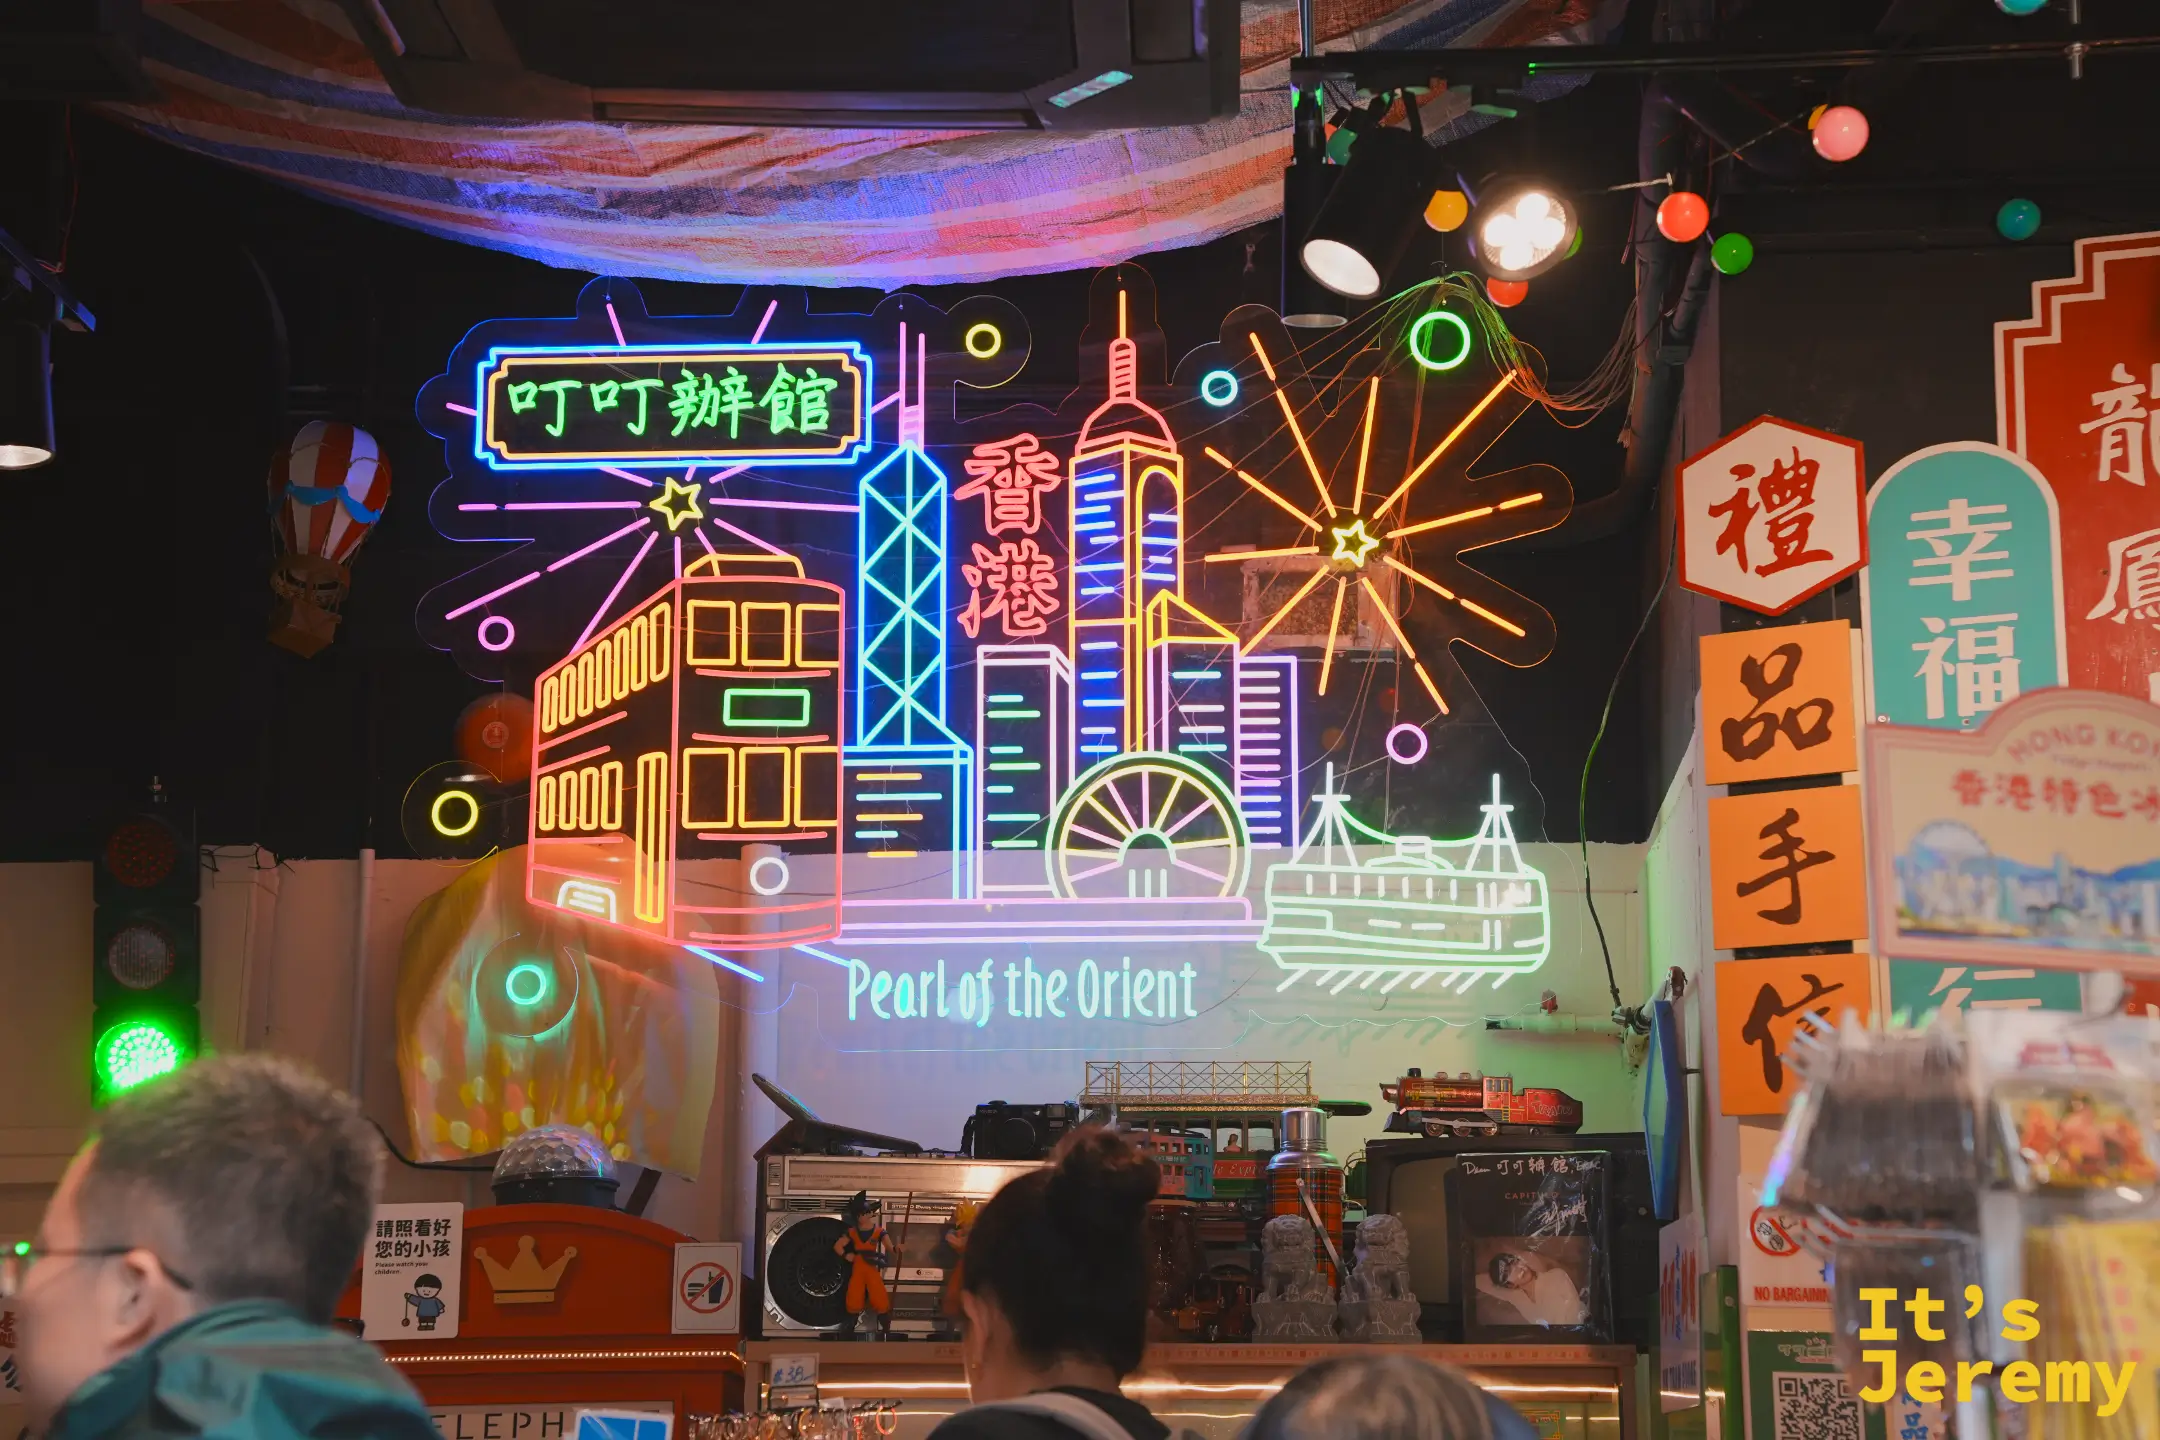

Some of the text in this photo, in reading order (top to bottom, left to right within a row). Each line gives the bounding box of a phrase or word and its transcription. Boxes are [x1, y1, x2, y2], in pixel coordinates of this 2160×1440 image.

[507, 362, 838, 438] 叮叮辦館
[953, 432, 1061, 638] 香港
[1708, 446, 1834, 577] 禮
[1906, 498, 2022, 719] 幸福
[1721, 643, 1833, 762] 品
[1736, 808, 1836, 924] 手
[849, 956, 1198, 1028] Pearl of the Orient
[375, 1239, 451, 1258] 您的小孩
[376, 1219, 451, 1238] 請照看好
[1754, 1286, 1770, 1300] NO
